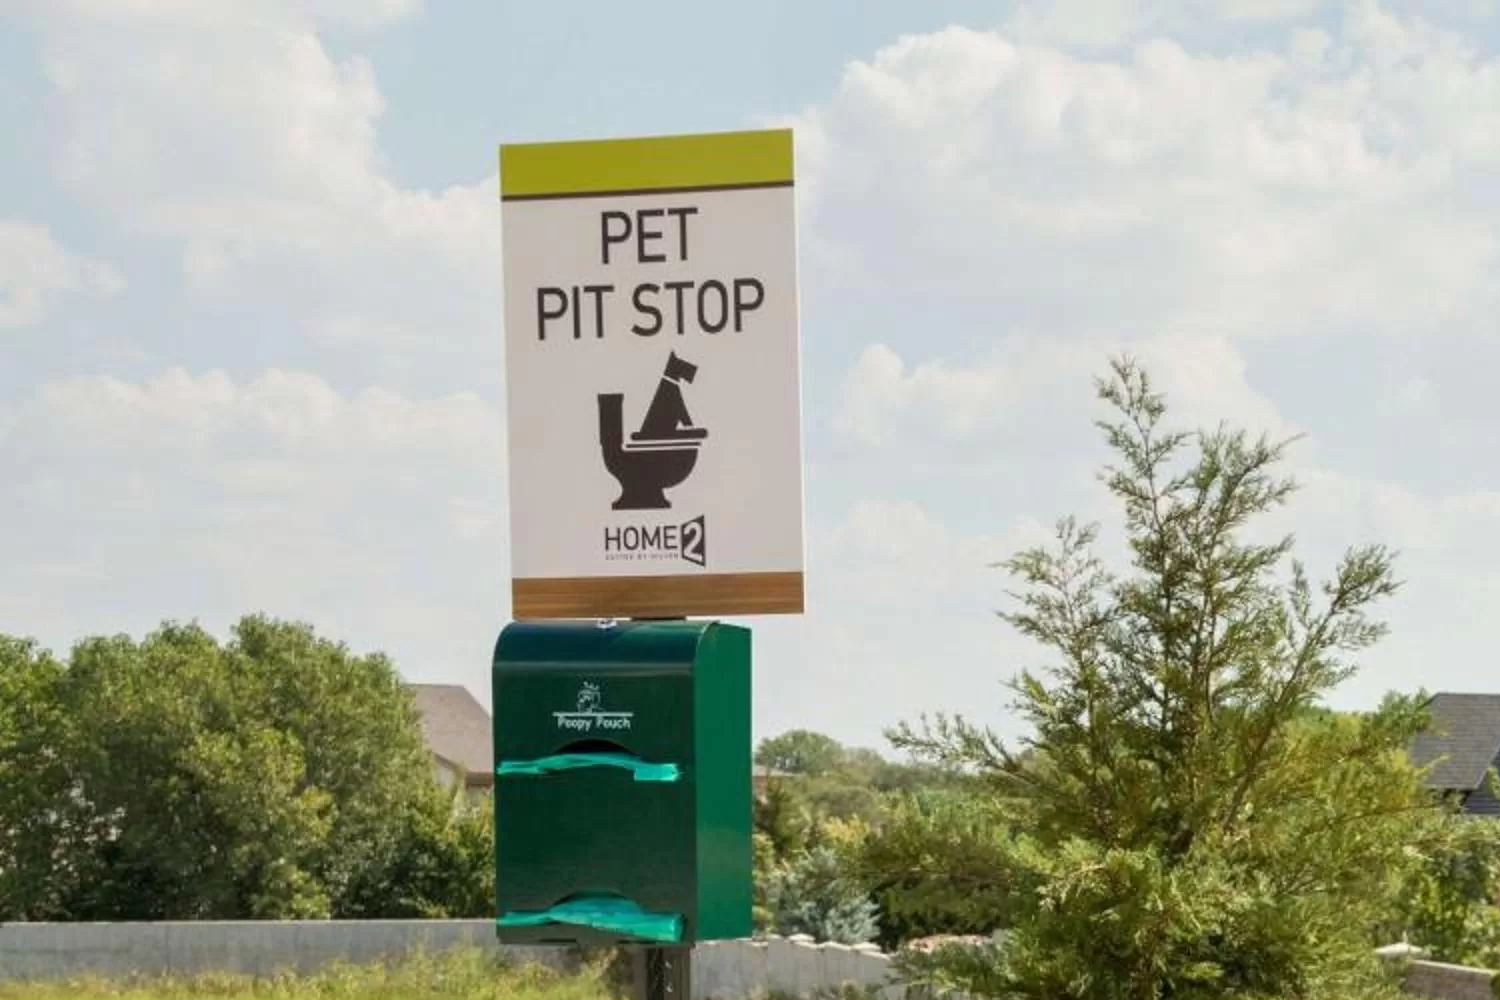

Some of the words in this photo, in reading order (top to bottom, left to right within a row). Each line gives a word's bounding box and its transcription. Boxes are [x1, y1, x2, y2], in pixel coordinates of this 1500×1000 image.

[600, 207, 698, 264] PET
[537, 286, 614, 340] PIT
[632, 278, 765, 337] STOP
[558, 715, 591, 731] Poopy
[597, 715, 631, 729] Pouch
